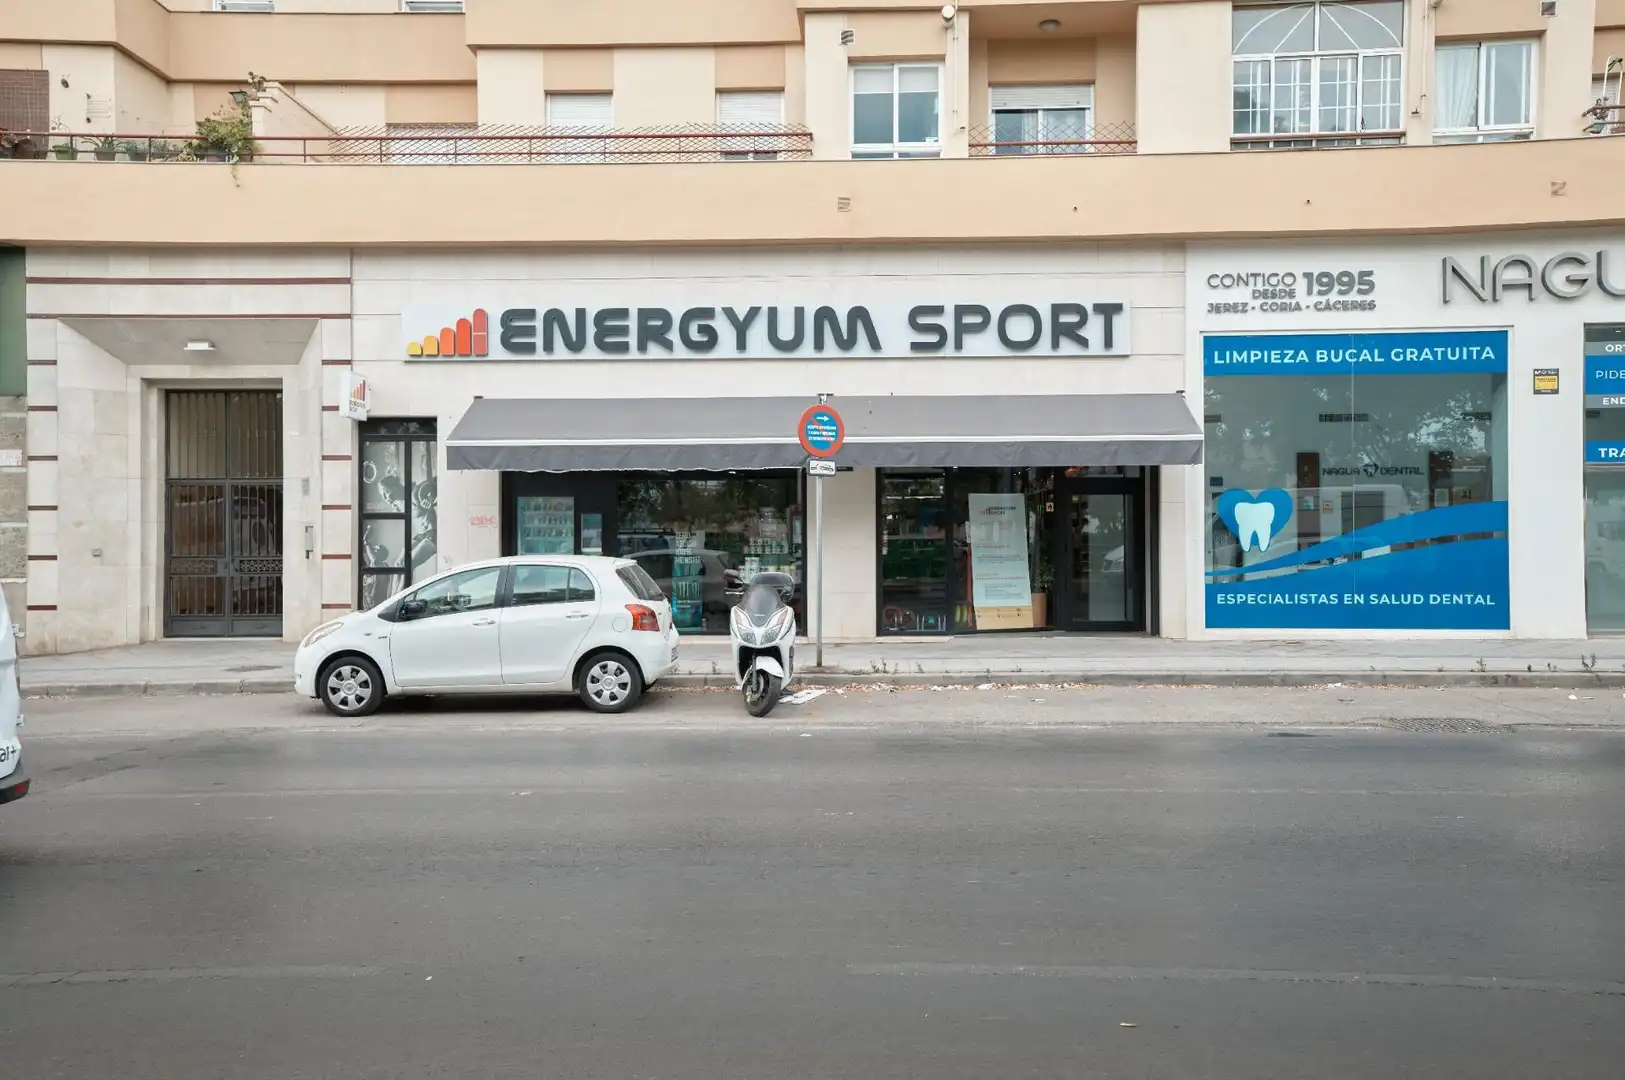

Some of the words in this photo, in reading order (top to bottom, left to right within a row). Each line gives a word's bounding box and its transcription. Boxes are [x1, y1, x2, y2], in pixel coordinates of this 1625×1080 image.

[1207, 272, 1297, 289] CONTIGO
[1302, 270, 1376, 296] 1995
[1251, 288, 1296, 300] DESDE
[1207, 302, 1248, 314] JEREZ
[1259, 301, 1302, 312] CORIA
[1313, 298, 1377, 311] CÁCERES
[500, 305, 882, 353] ENERGYUM
[907, 302, 1123, 351] SPORT
[1214, 350, 1309, 364] LIMPIEZA
[1316, 349, 1384, 363] BUCAL
[1390, 346, 1495, 362] GRATUITA
[1322, 467, 1360, 476] NAGUA
[1380, 466, 1425, 476] DENTAL
[1216, 593, 1339, 605] ESPECIALISTAS
[1343, 593, 1365, 605] EN
[1369, 593, 1424, 605] SALUD
[1429, 594, 1496, 606] DENTAL
